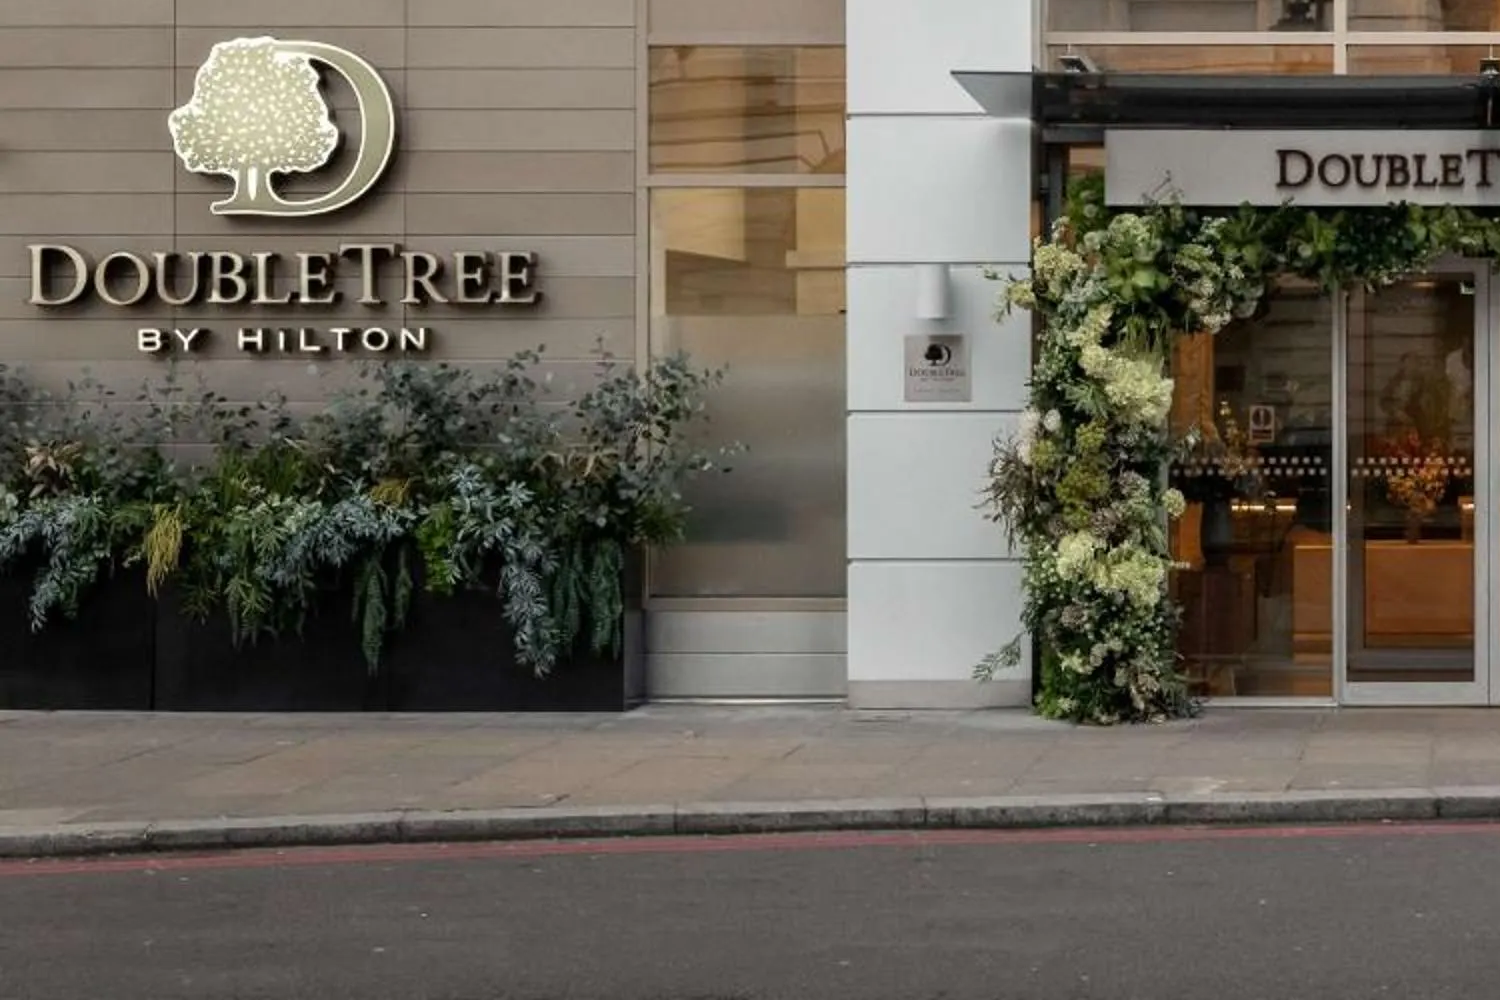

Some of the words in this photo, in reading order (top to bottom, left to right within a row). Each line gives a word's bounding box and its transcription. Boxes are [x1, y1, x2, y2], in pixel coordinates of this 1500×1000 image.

[26, 243, 540, 306] DOUBLETREE
[137, 327, 200, 352] BY
[237, 327, 427, 352] HILTON
